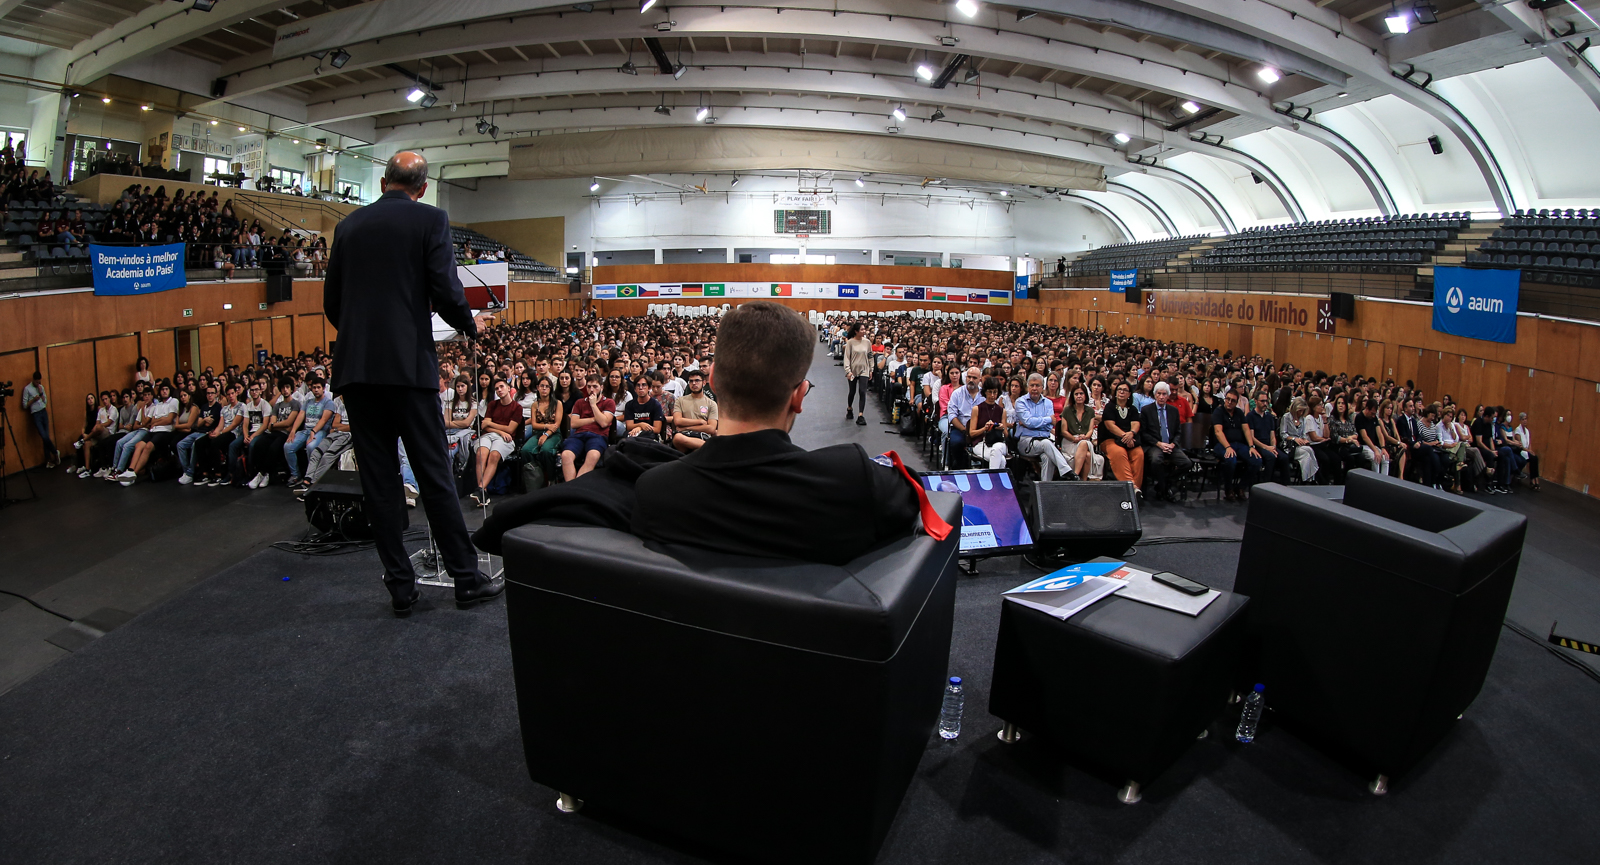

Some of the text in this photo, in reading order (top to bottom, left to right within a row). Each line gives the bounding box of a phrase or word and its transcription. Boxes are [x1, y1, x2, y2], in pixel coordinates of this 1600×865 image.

[98, 252, 179, 265] Bem-vindos à melhor
[105, 263, 174, 279] Academia do País!
[1160, 295, 1308, 327] Universidade do Minho
[1468, 296, 1504, 314] aaum
